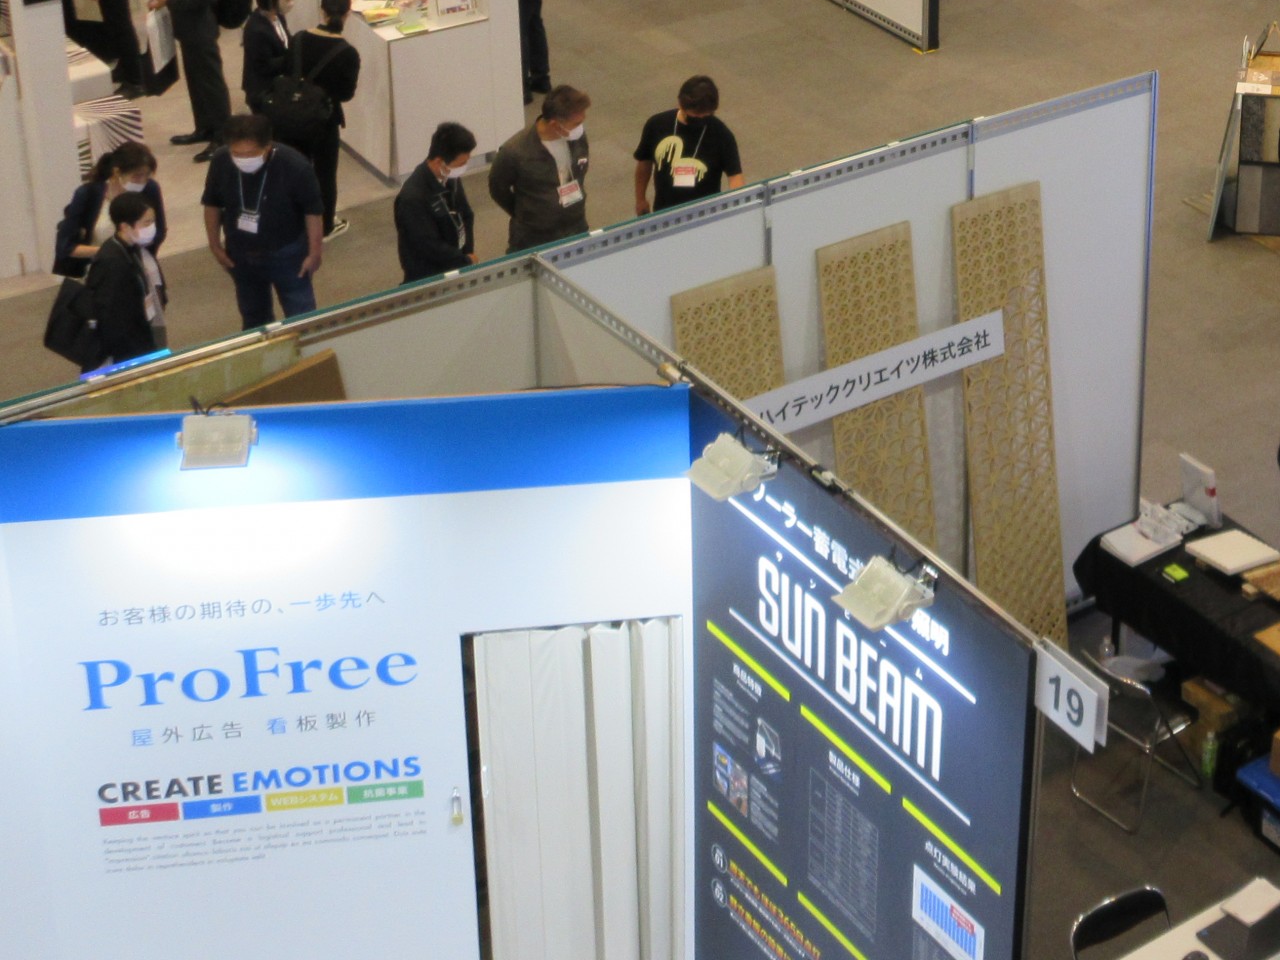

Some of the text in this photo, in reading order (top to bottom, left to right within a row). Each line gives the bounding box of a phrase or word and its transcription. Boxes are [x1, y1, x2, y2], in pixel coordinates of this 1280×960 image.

[757, 329, 992, 425] ハイテッククリエイツ株式会社
[98, 590, 387, 628] お客様の期待の、一歩先へ
[77, 646, 419, 712] ProFree
[758, 554, 827, 681] SUN
[835, 618, 943, 783] BEAM
[131, 709, 377, 747] 屋外広告 看板製作
[1048, 674, 1085, 728] 19
[97, 755, 423, 805] CREATE EMOTIONS
